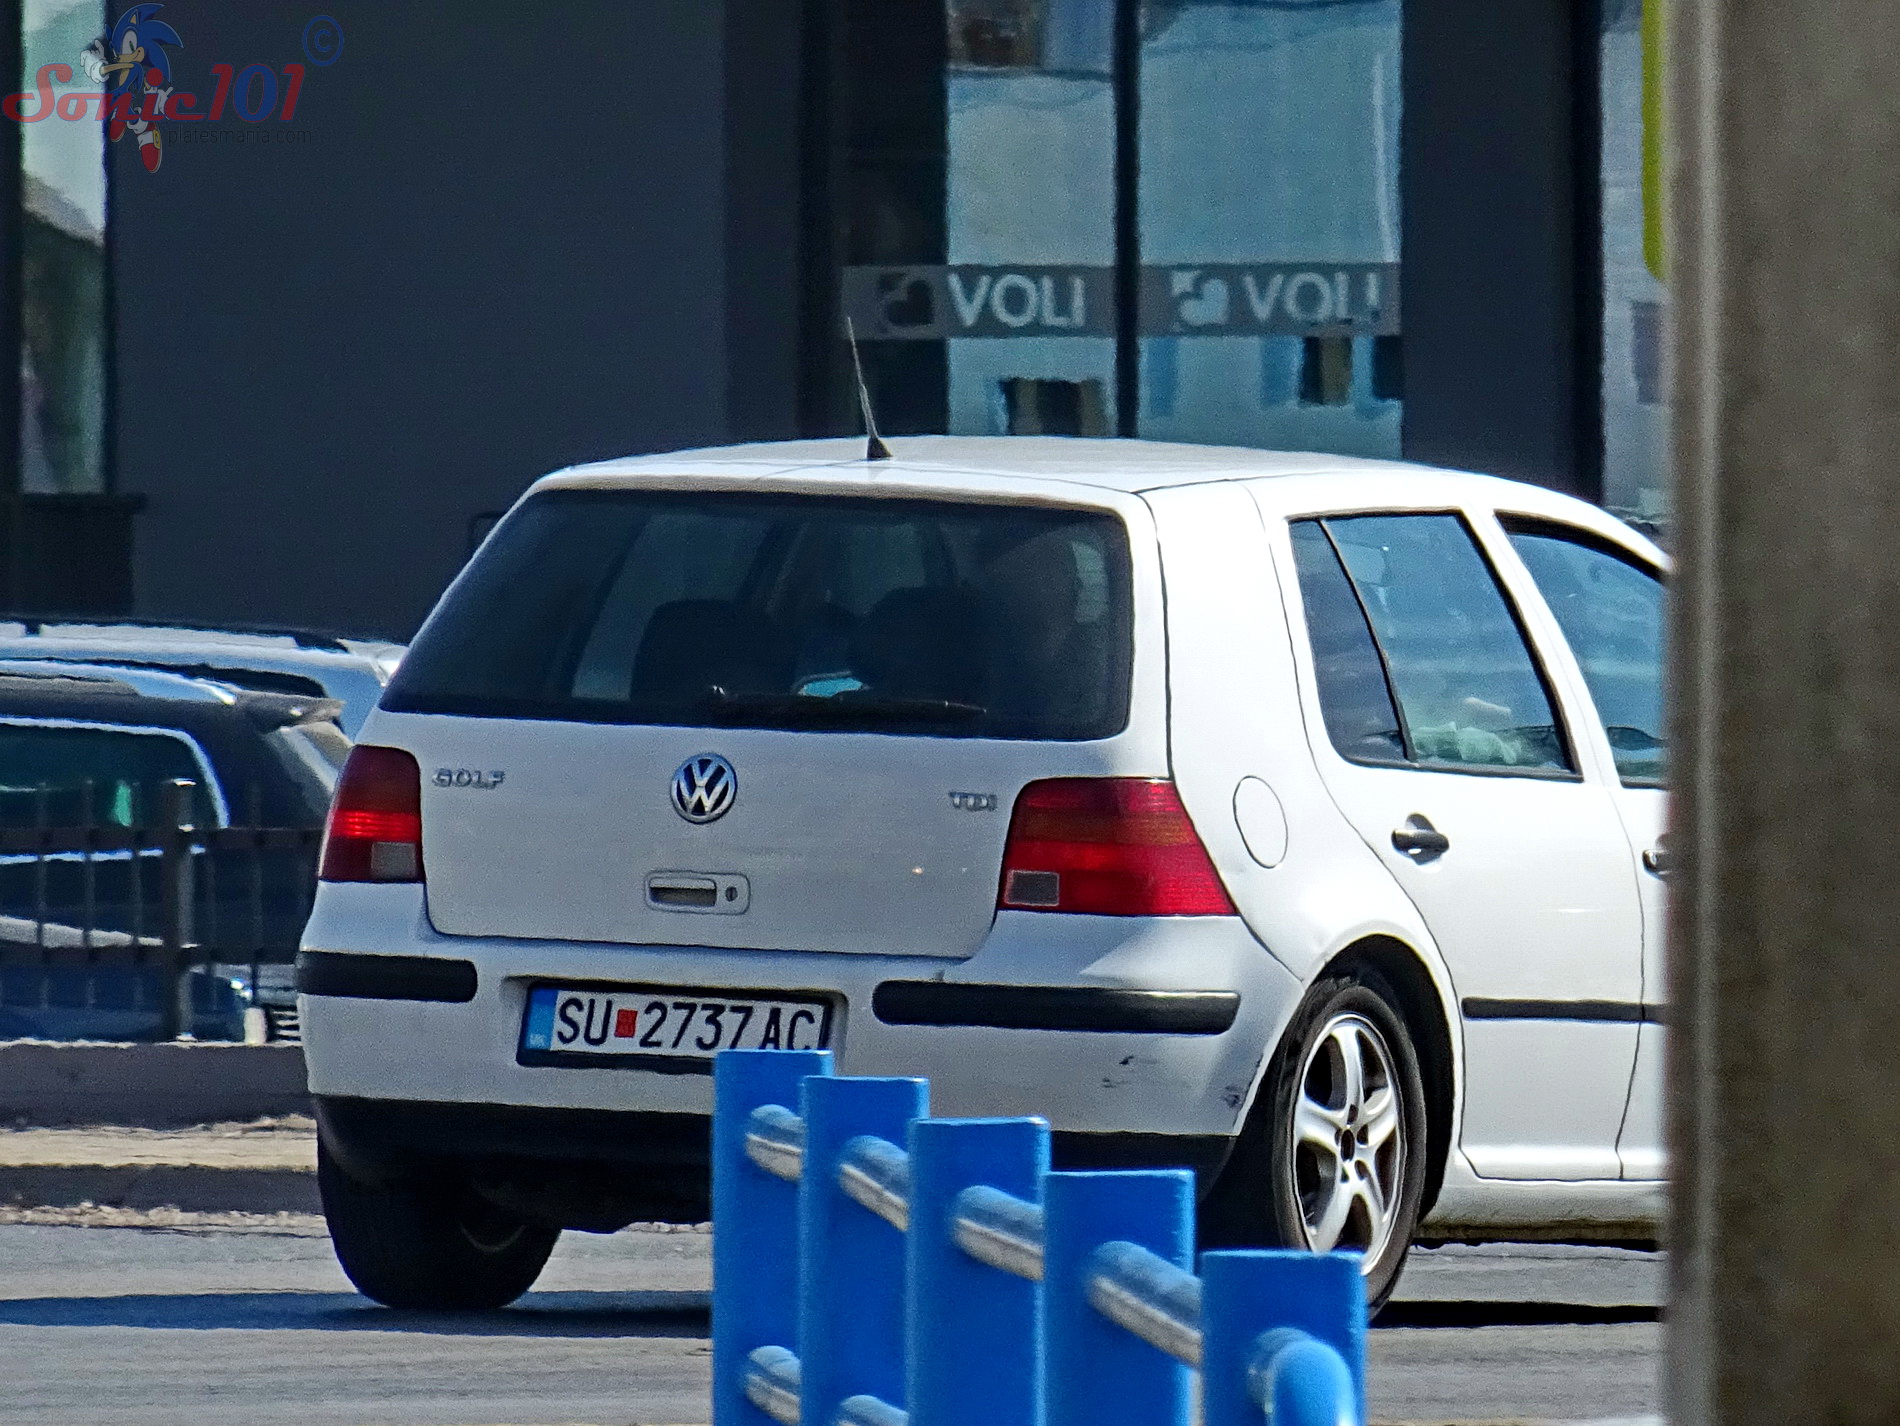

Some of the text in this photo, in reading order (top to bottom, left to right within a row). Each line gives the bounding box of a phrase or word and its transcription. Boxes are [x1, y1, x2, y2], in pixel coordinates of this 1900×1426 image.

[948, 273, 1087, 327] VOLI
[432, 768, 505, 789] GOLF
[949, 791, 998, 812] TDI
[557, 998, 815, 1050] SU 2737 AC
